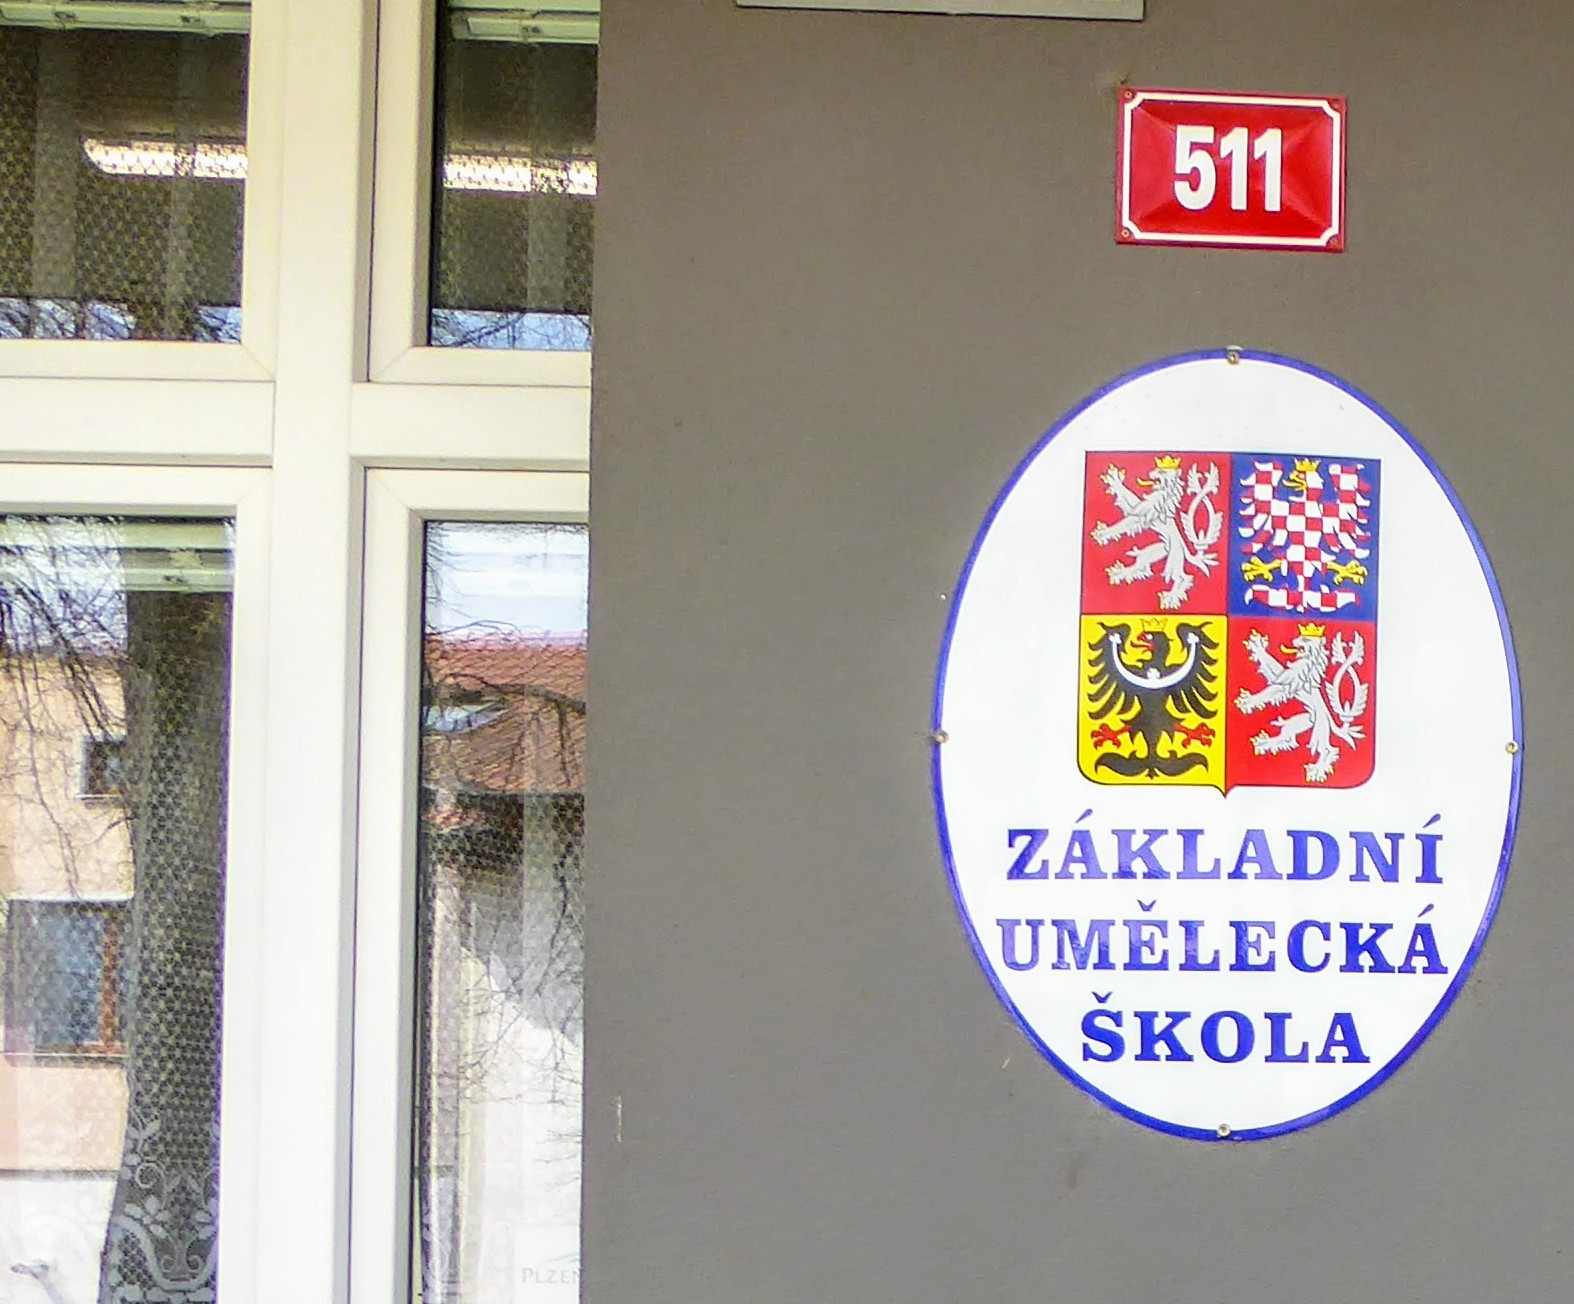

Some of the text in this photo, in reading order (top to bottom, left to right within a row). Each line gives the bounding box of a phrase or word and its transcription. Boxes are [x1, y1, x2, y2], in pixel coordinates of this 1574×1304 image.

[1174, 125, 1282, 212] 511
[1007, 809, 1443, 884] ZÁKLADNÍ
[996, 901, 1447, 975] UMĚLECKÁ
[1081, 992, 1370, 1063] ŠKOLA
